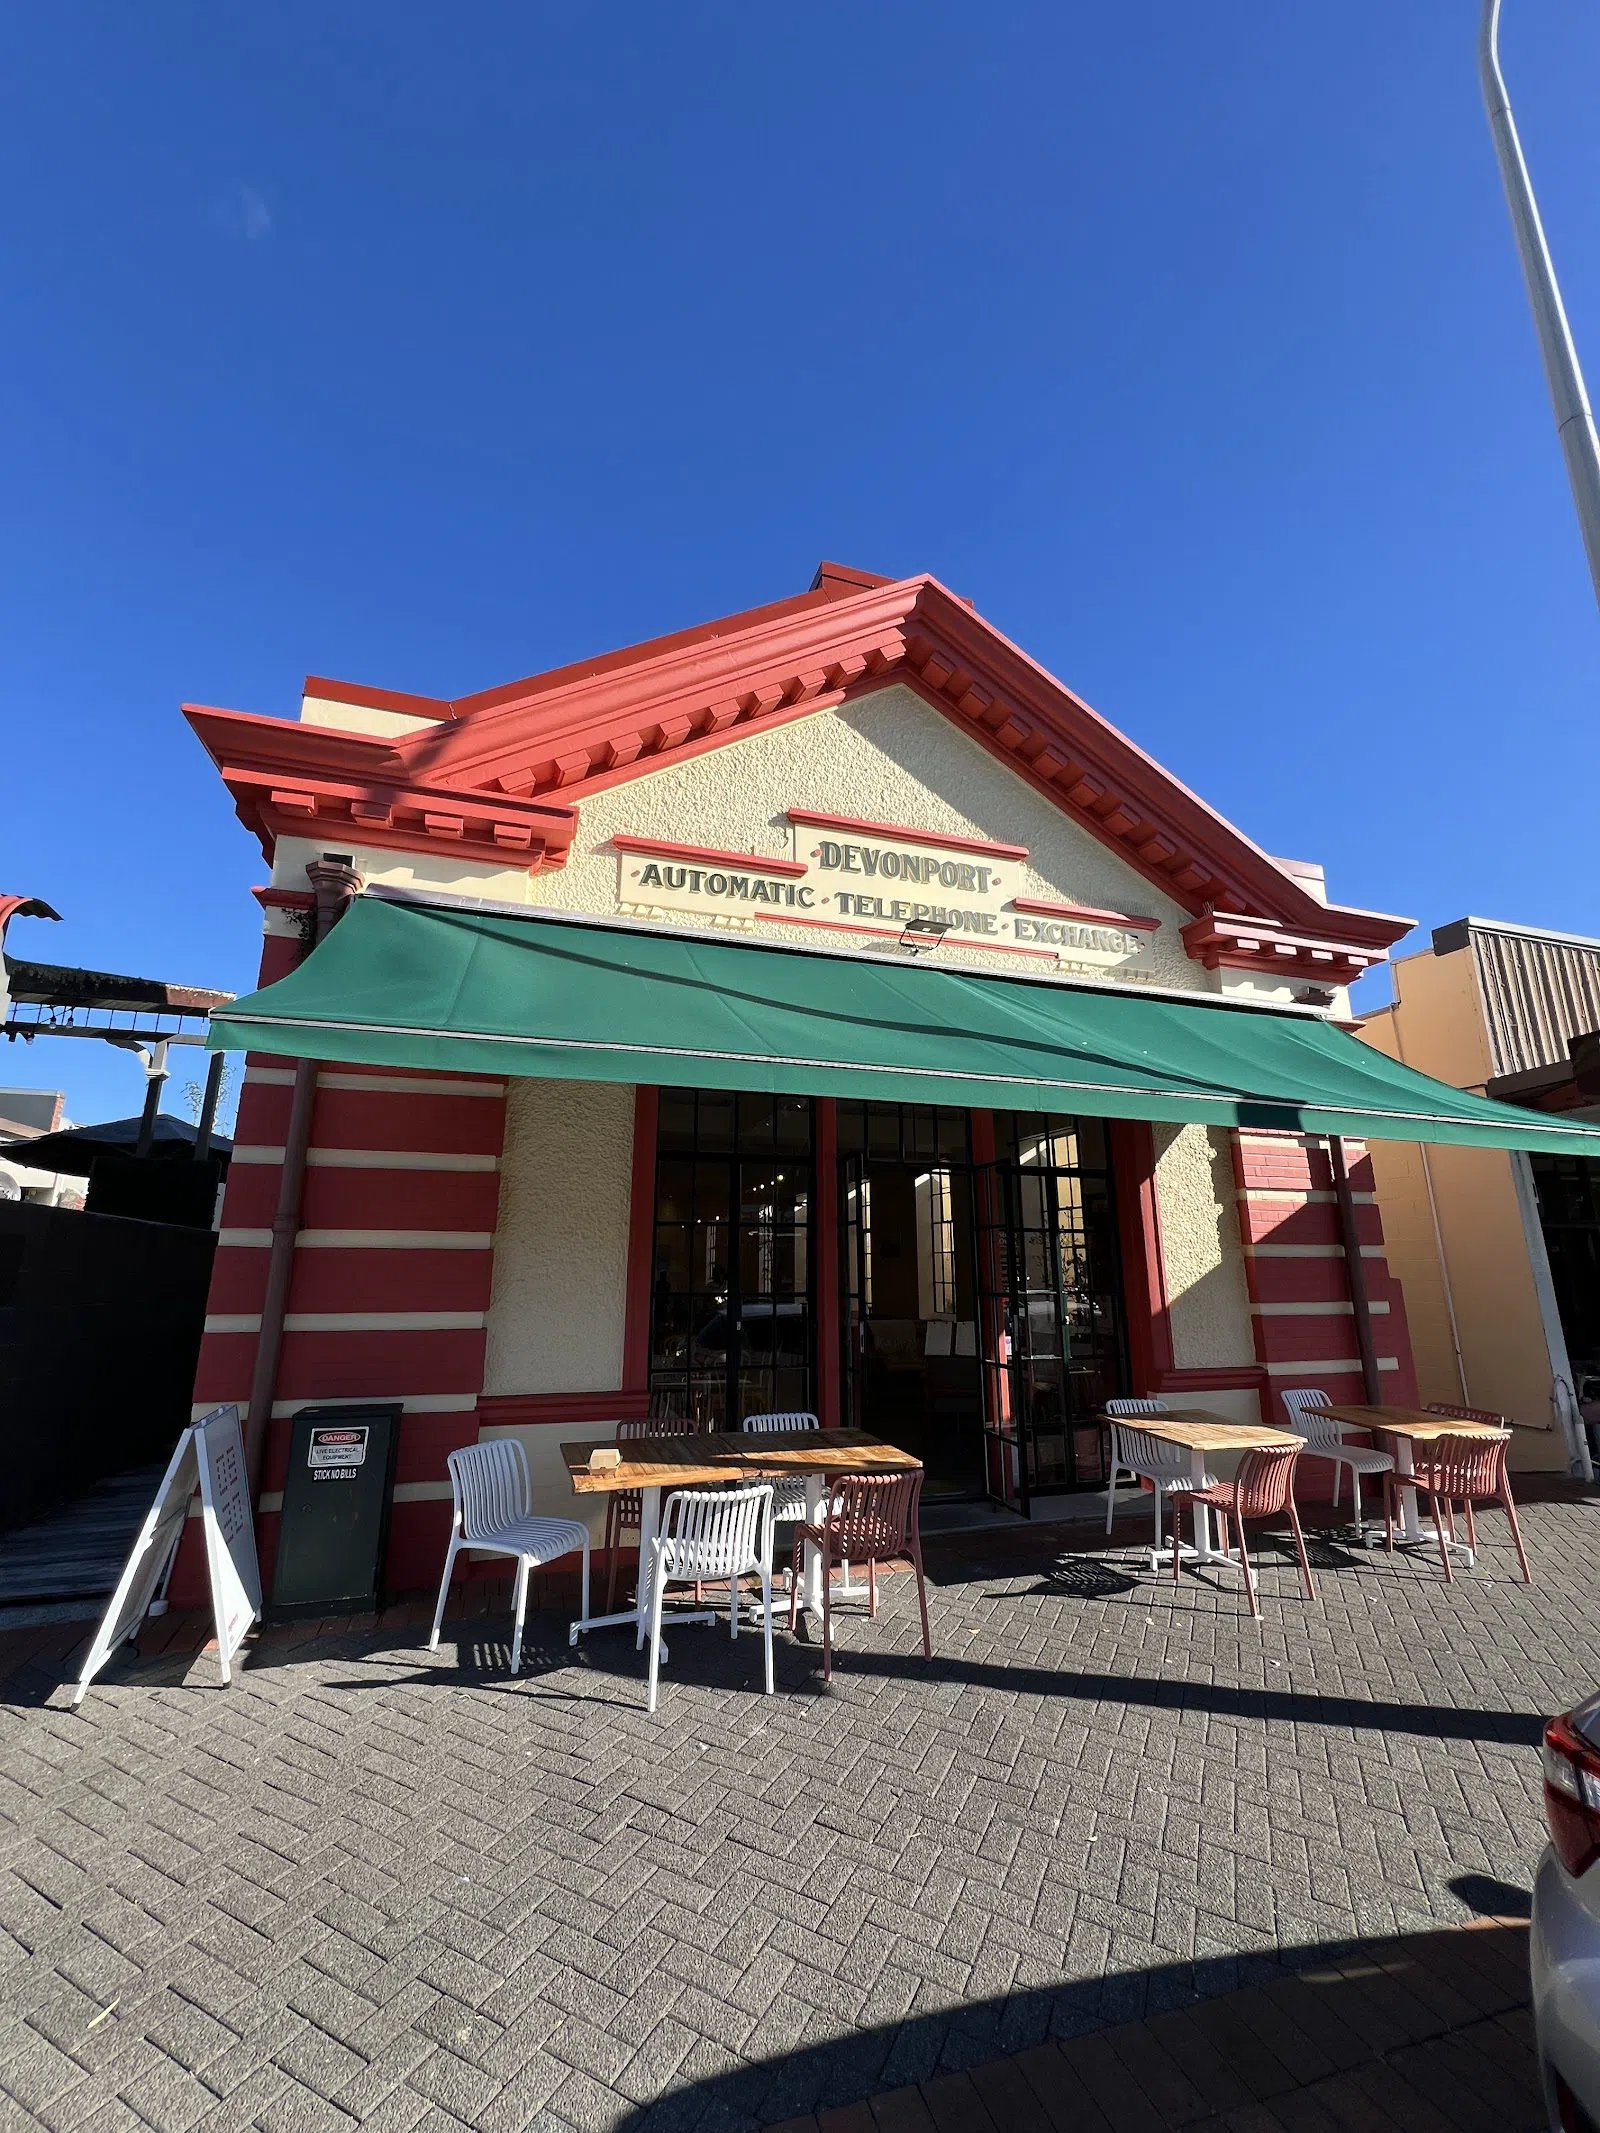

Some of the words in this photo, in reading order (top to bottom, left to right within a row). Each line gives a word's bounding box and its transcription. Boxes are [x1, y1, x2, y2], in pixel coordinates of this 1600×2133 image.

[818, 840, 993, 894] DEVONPORT
[639, 863, 816, 910] AUTOMATIC
[834, 891, 999, 936] TELEPHONE
[1014, 918, 1141, 955] EXCHANGE
[321, 1434, 358, 1442] DANGER
[313, 1469, 331, 1480] STICK
[331, 1469, 340, 1479] NO
[340, 1468, 357, 1479] BILLS
